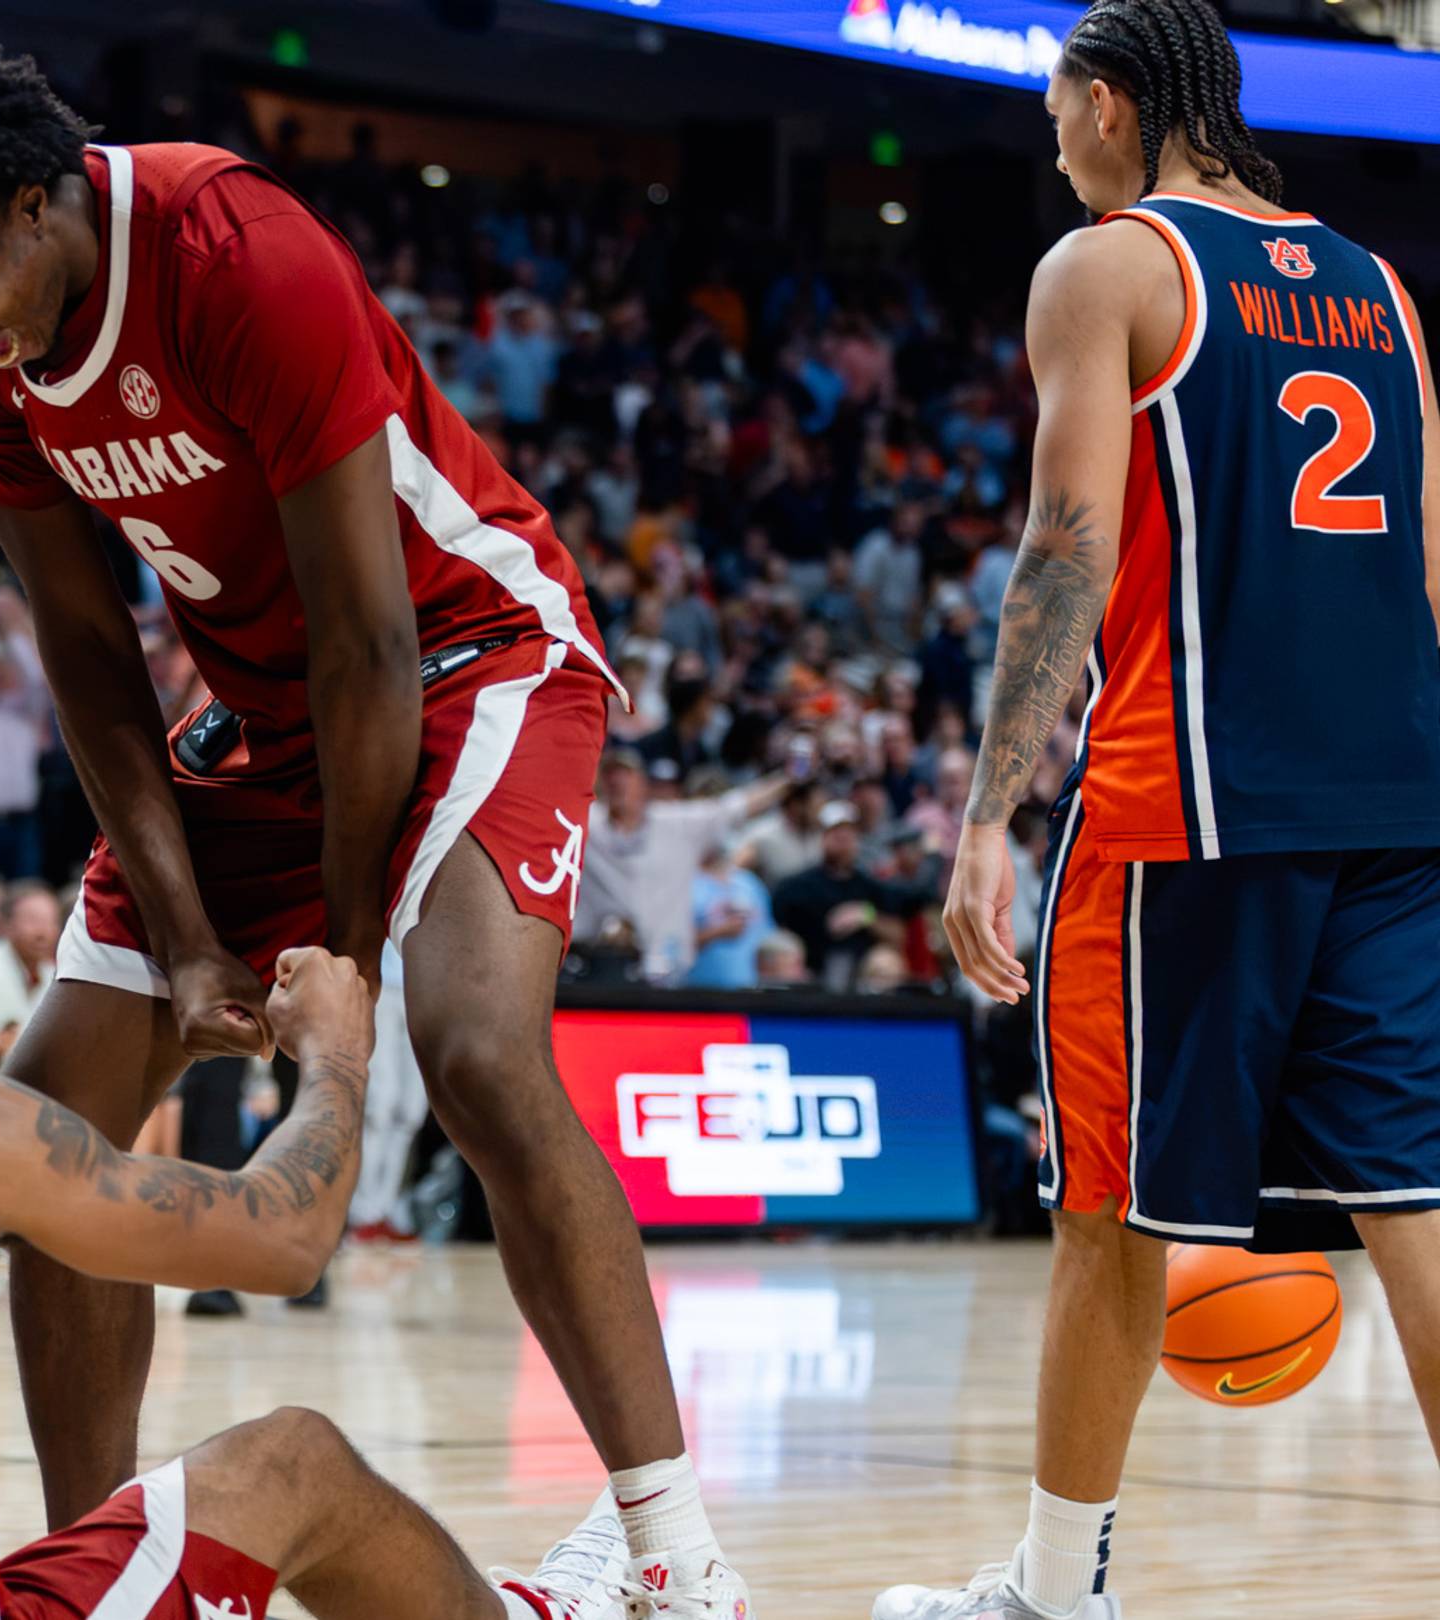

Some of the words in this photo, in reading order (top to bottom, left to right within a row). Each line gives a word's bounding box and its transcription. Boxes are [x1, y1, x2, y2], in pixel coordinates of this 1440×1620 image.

[1229, 281, 1394, 354] WILLIAMS
[122, 369, 158, 416] SEC
[1277, 370, 1388, 533] 2
[120, 516, 222, 600] 6
